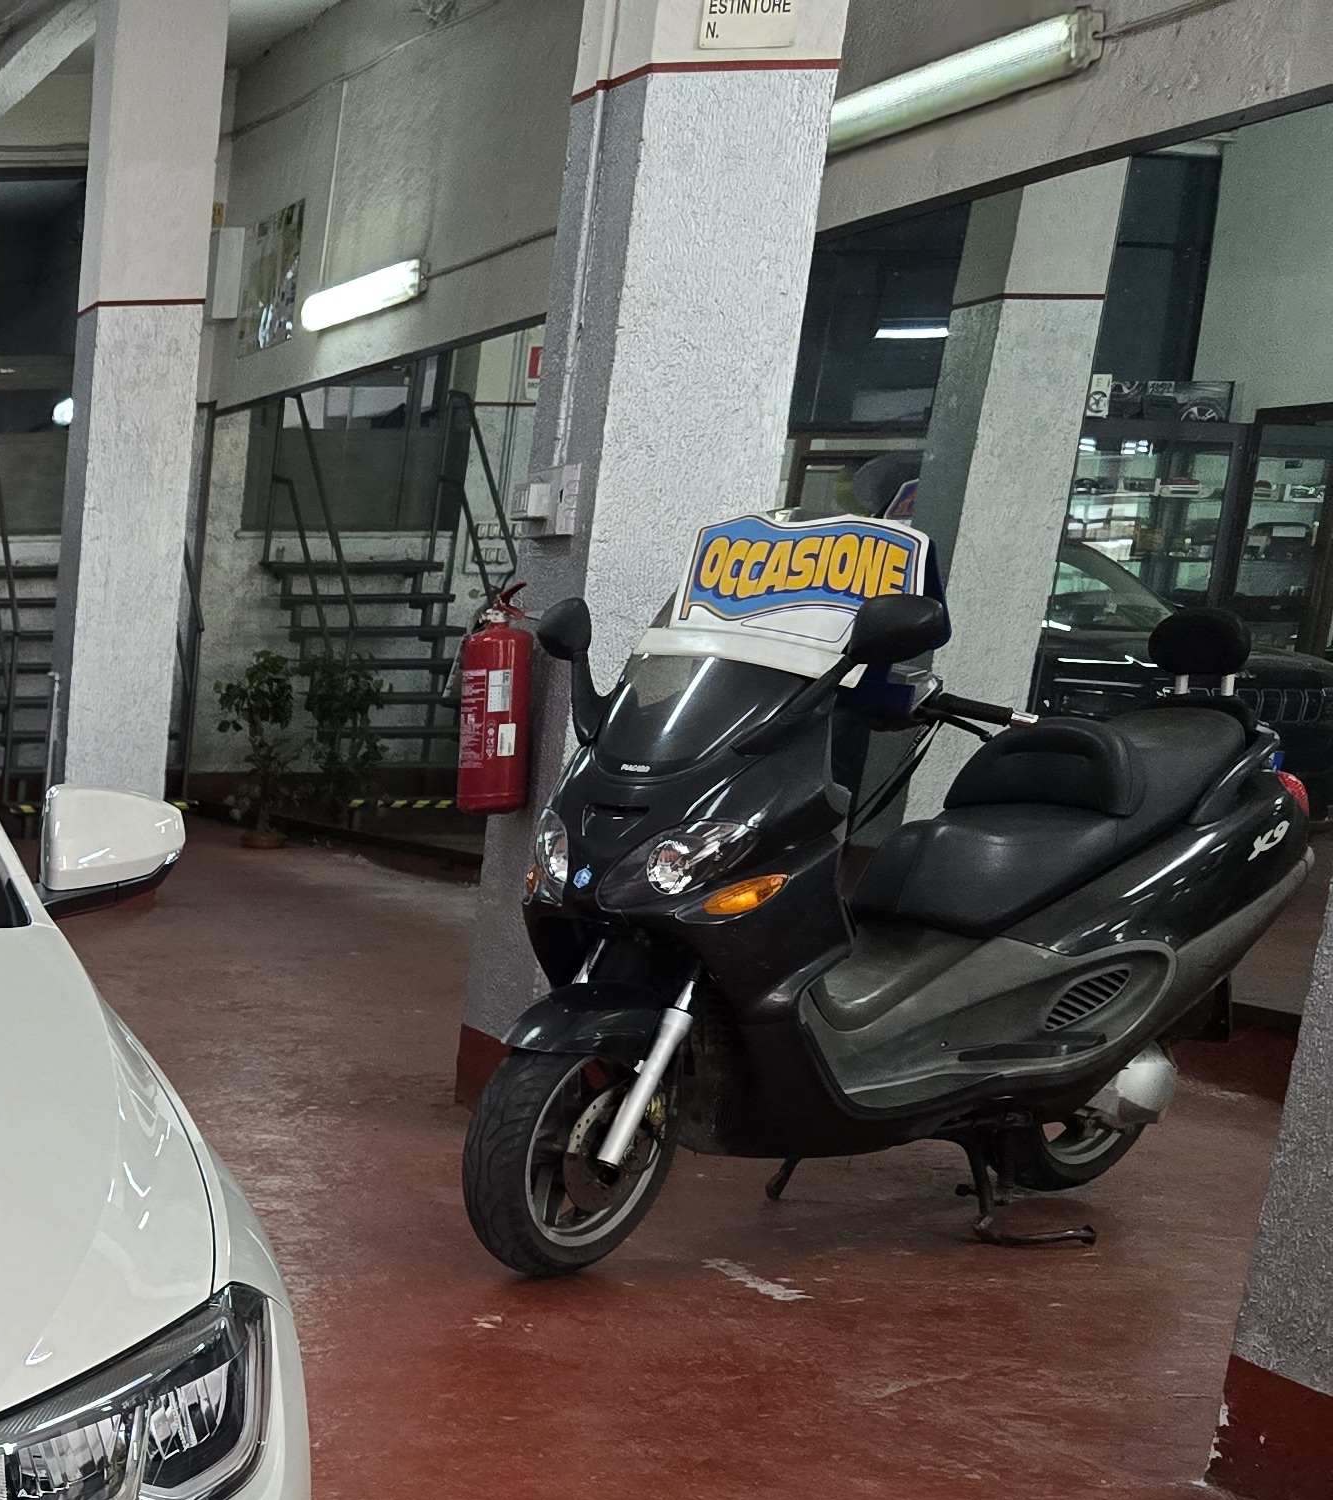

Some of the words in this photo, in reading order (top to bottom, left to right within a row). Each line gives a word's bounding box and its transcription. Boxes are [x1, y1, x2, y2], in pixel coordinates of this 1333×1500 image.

[708, 0, 791, 14] ESTINTORE
[705, 21, 719, 38] N.
[698, 533, 910, 599] OCCASIONE
